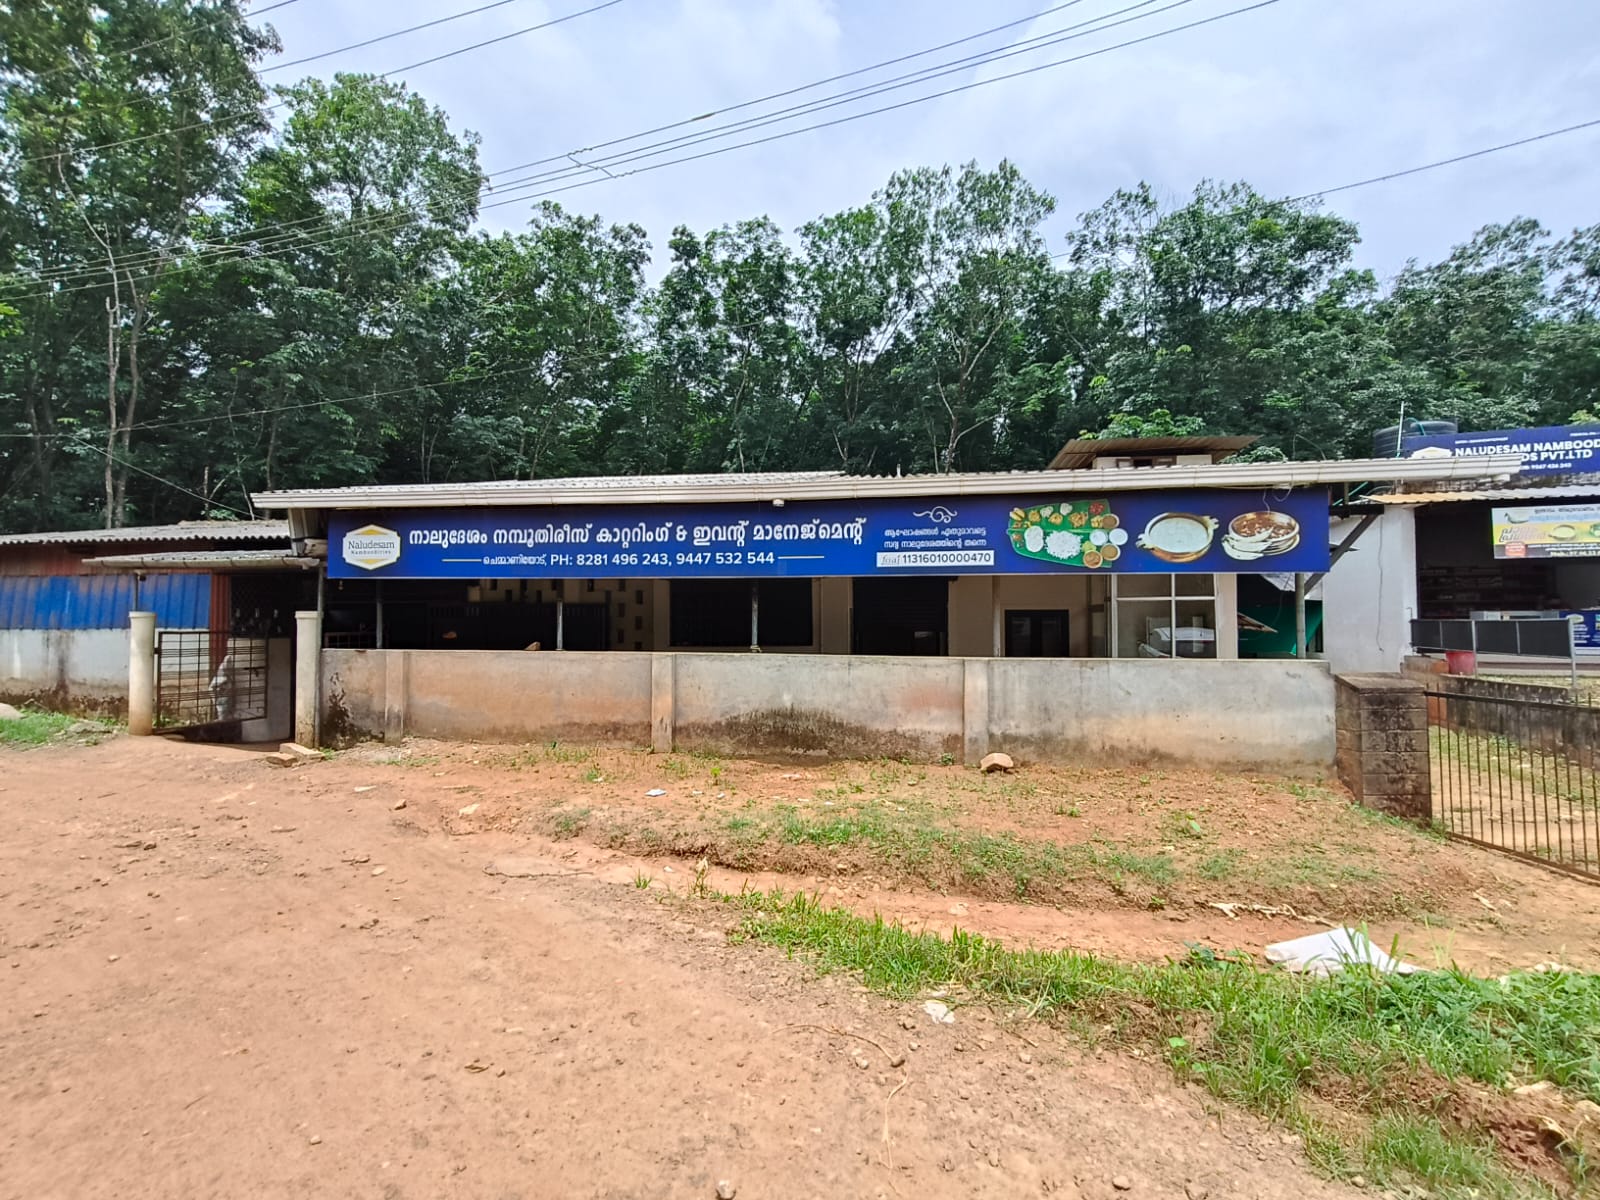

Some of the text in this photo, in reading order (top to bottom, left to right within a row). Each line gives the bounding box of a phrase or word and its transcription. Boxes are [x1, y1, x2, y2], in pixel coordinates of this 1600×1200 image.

[1455, 443, 1531, 457] NALUDESAM
[1540, 449, 1593, 461] PVT.LTD
[409, 529, 488, 549] നാലുദേശം
[493, 524, 593, 548] നമ്പൂതിരീസ്
[595, 522, 673, 549] കാറ്ററിംഗ്
[675, 524, 688, 542] &
[348, 541, 395, 550] Naludesam
[550, 554, 573, 566] PH:
[576, 553, 608, 566] 8281
[611, 553, 638, 566] 496
[642, 553, 672, 566] 243,
[676, 552, 711, 565] 9447
[715, 552, 742, 565] 532
[747, 551, 775, 564] 544
[902, 553, 991, 564] 11316010000470
